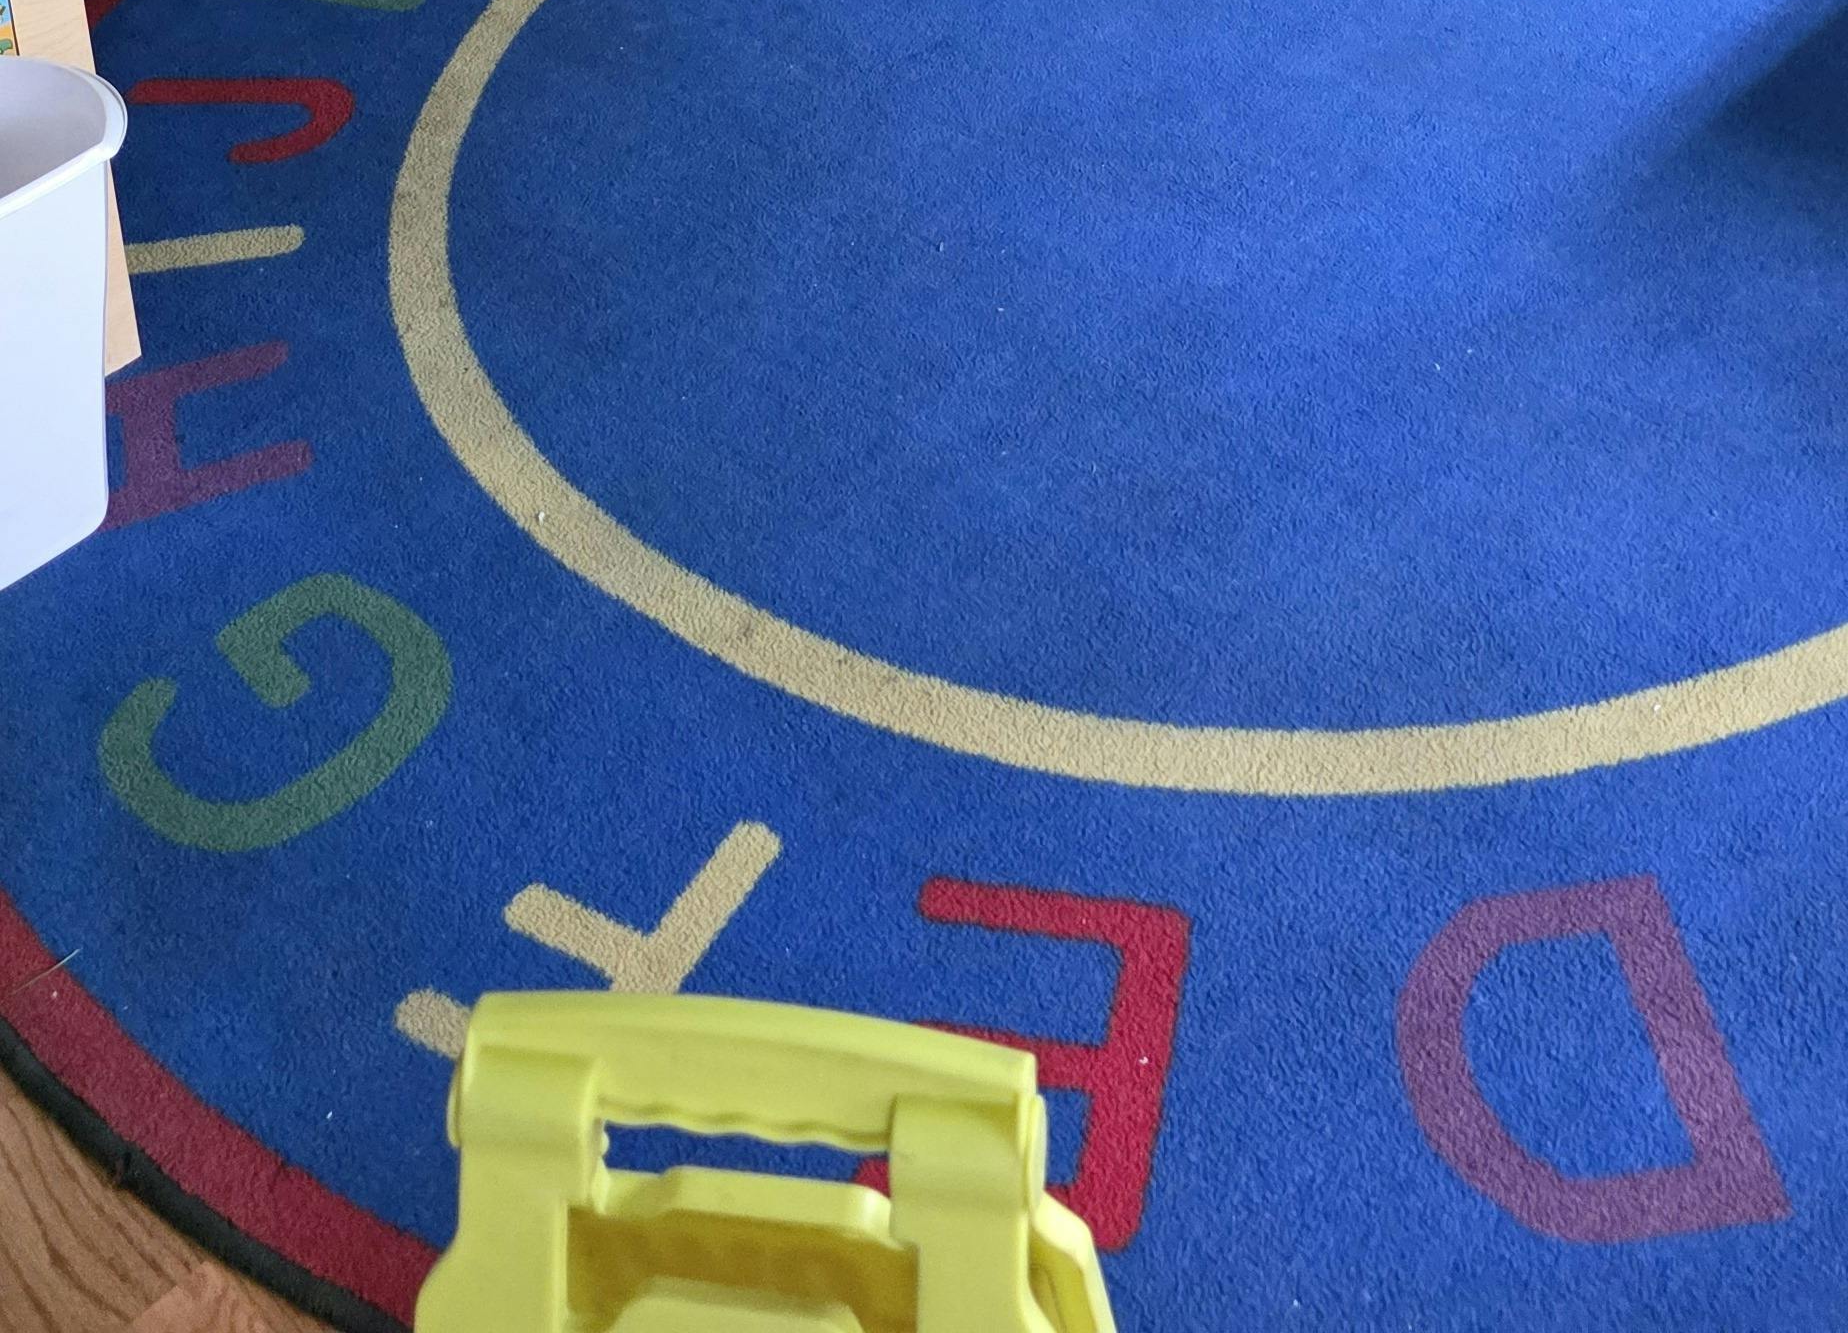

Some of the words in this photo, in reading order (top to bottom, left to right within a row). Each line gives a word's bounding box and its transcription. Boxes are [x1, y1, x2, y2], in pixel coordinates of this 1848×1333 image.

[126, 78, 355, 165] J
[104, 339, 315, 533] H
[99, 573, 455, 853] G
[853, 876, 1192, 1253] E
[1395, 873, 1792, 1243] D
